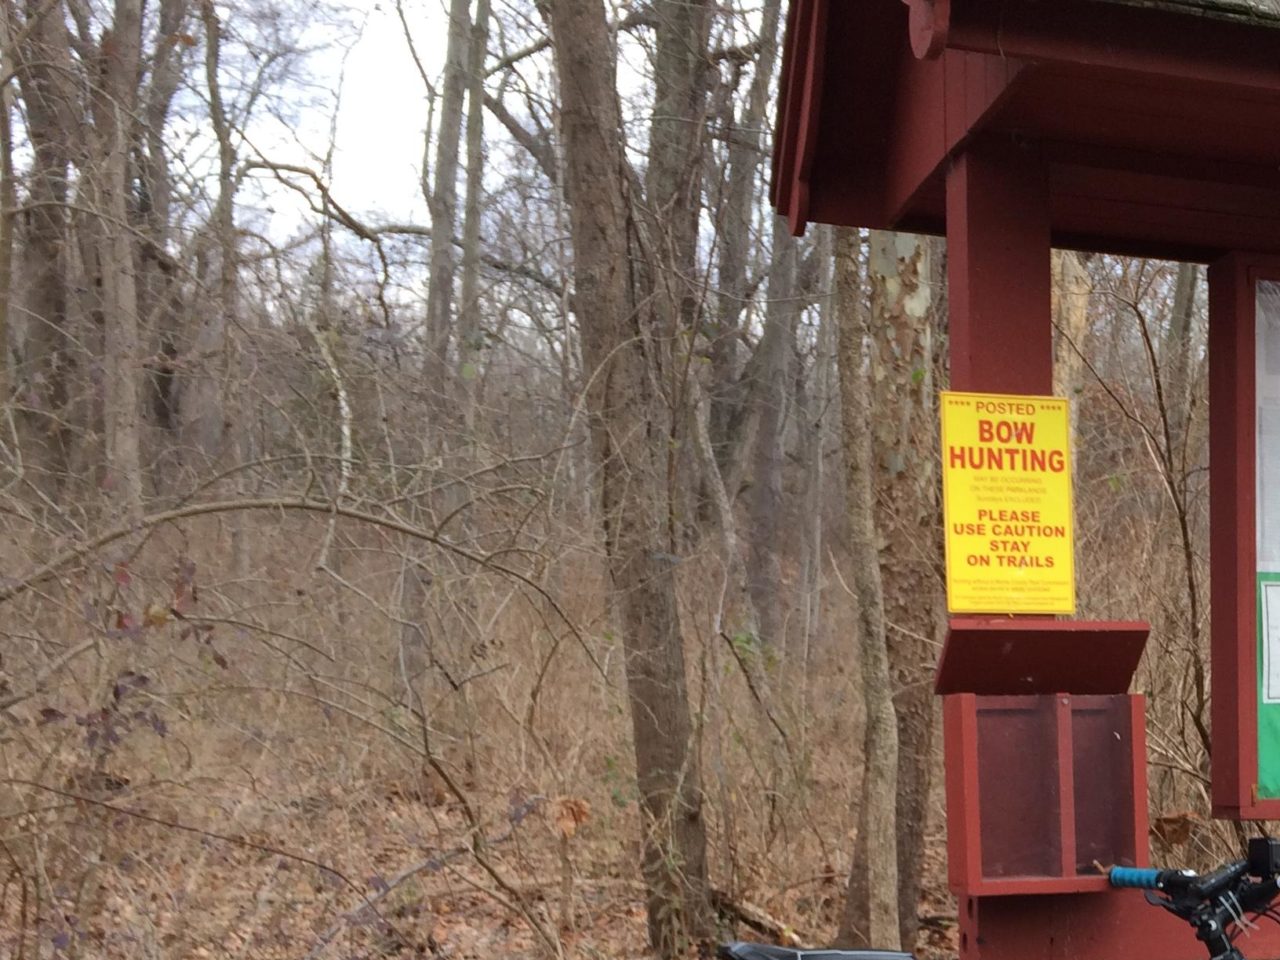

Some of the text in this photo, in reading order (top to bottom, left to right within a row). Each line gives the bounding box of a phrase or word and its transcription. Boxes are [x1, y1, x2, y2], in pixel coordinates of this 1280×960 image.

[976, 401, 1036, 416] POSTED
[979, 420, 1035, 444] BOW
[949, 445, 1065, 473] HUNTING
[978, 509, 1040, 523] PLEASE
[953, 523, 1065, 538] USE CAUTION
[990, 540, 1030, 552] STAY
[966, 554, 1055, 568] ON TRAILS
